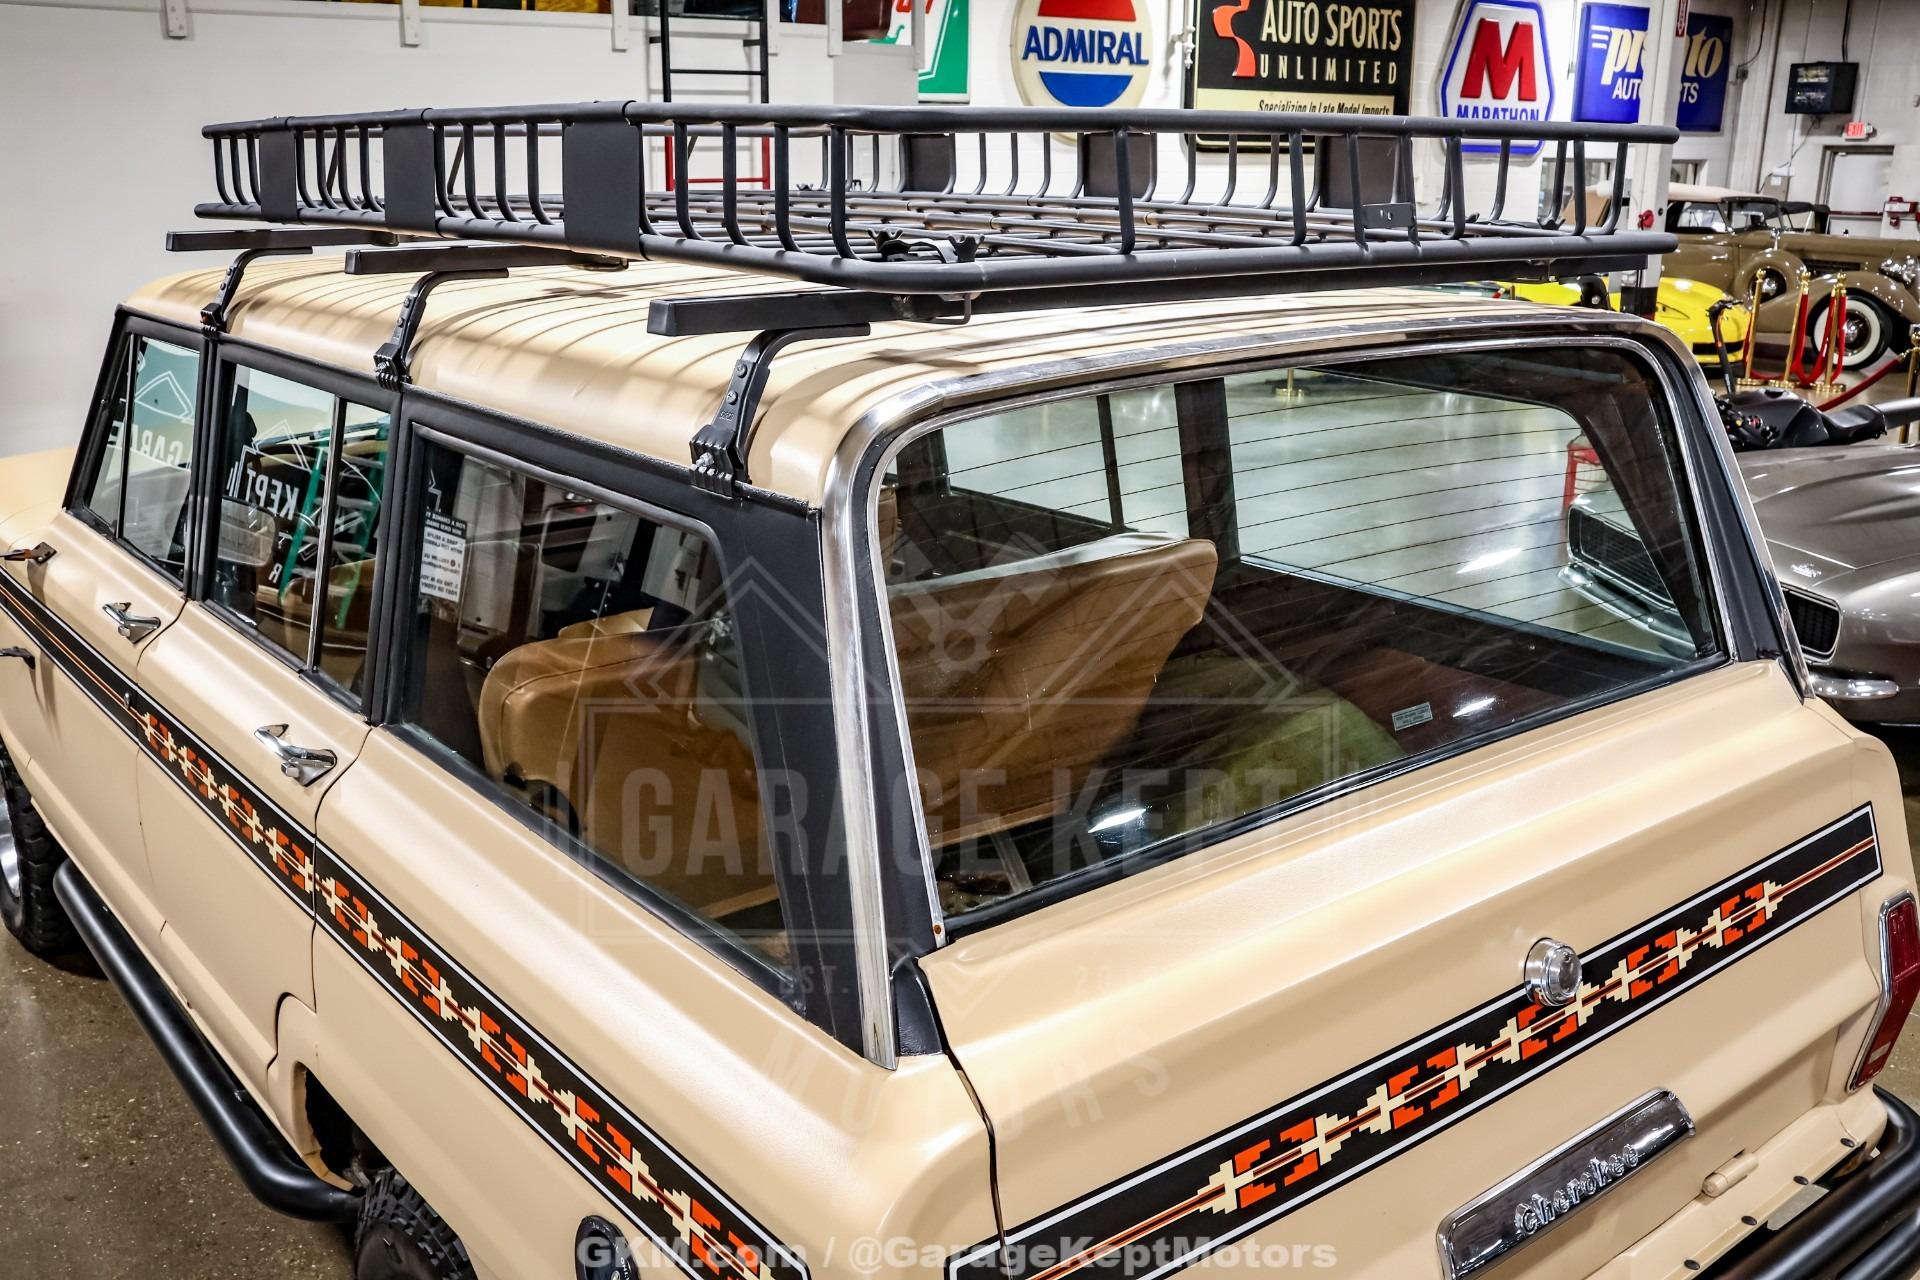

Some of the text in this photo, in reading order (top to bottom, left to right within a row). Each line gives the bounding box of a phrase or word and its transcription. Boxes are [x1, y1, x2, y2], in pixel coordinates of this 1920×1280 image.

[1022, 25, 1149, 65] ADMIRAL
[1260, 0, 1402, 51] AUTO SPORTS
[1259, 53, 1397, 85] UNLIMITED
[1460, 18, 1537, 101] M
[1601, 26, 1724, 85] prto
[1612, 77, 1642, 100] AUT
[1457, 104, 1539, 120] MARATHON
[1515, 1143, 1640, 1237] Cherokee
